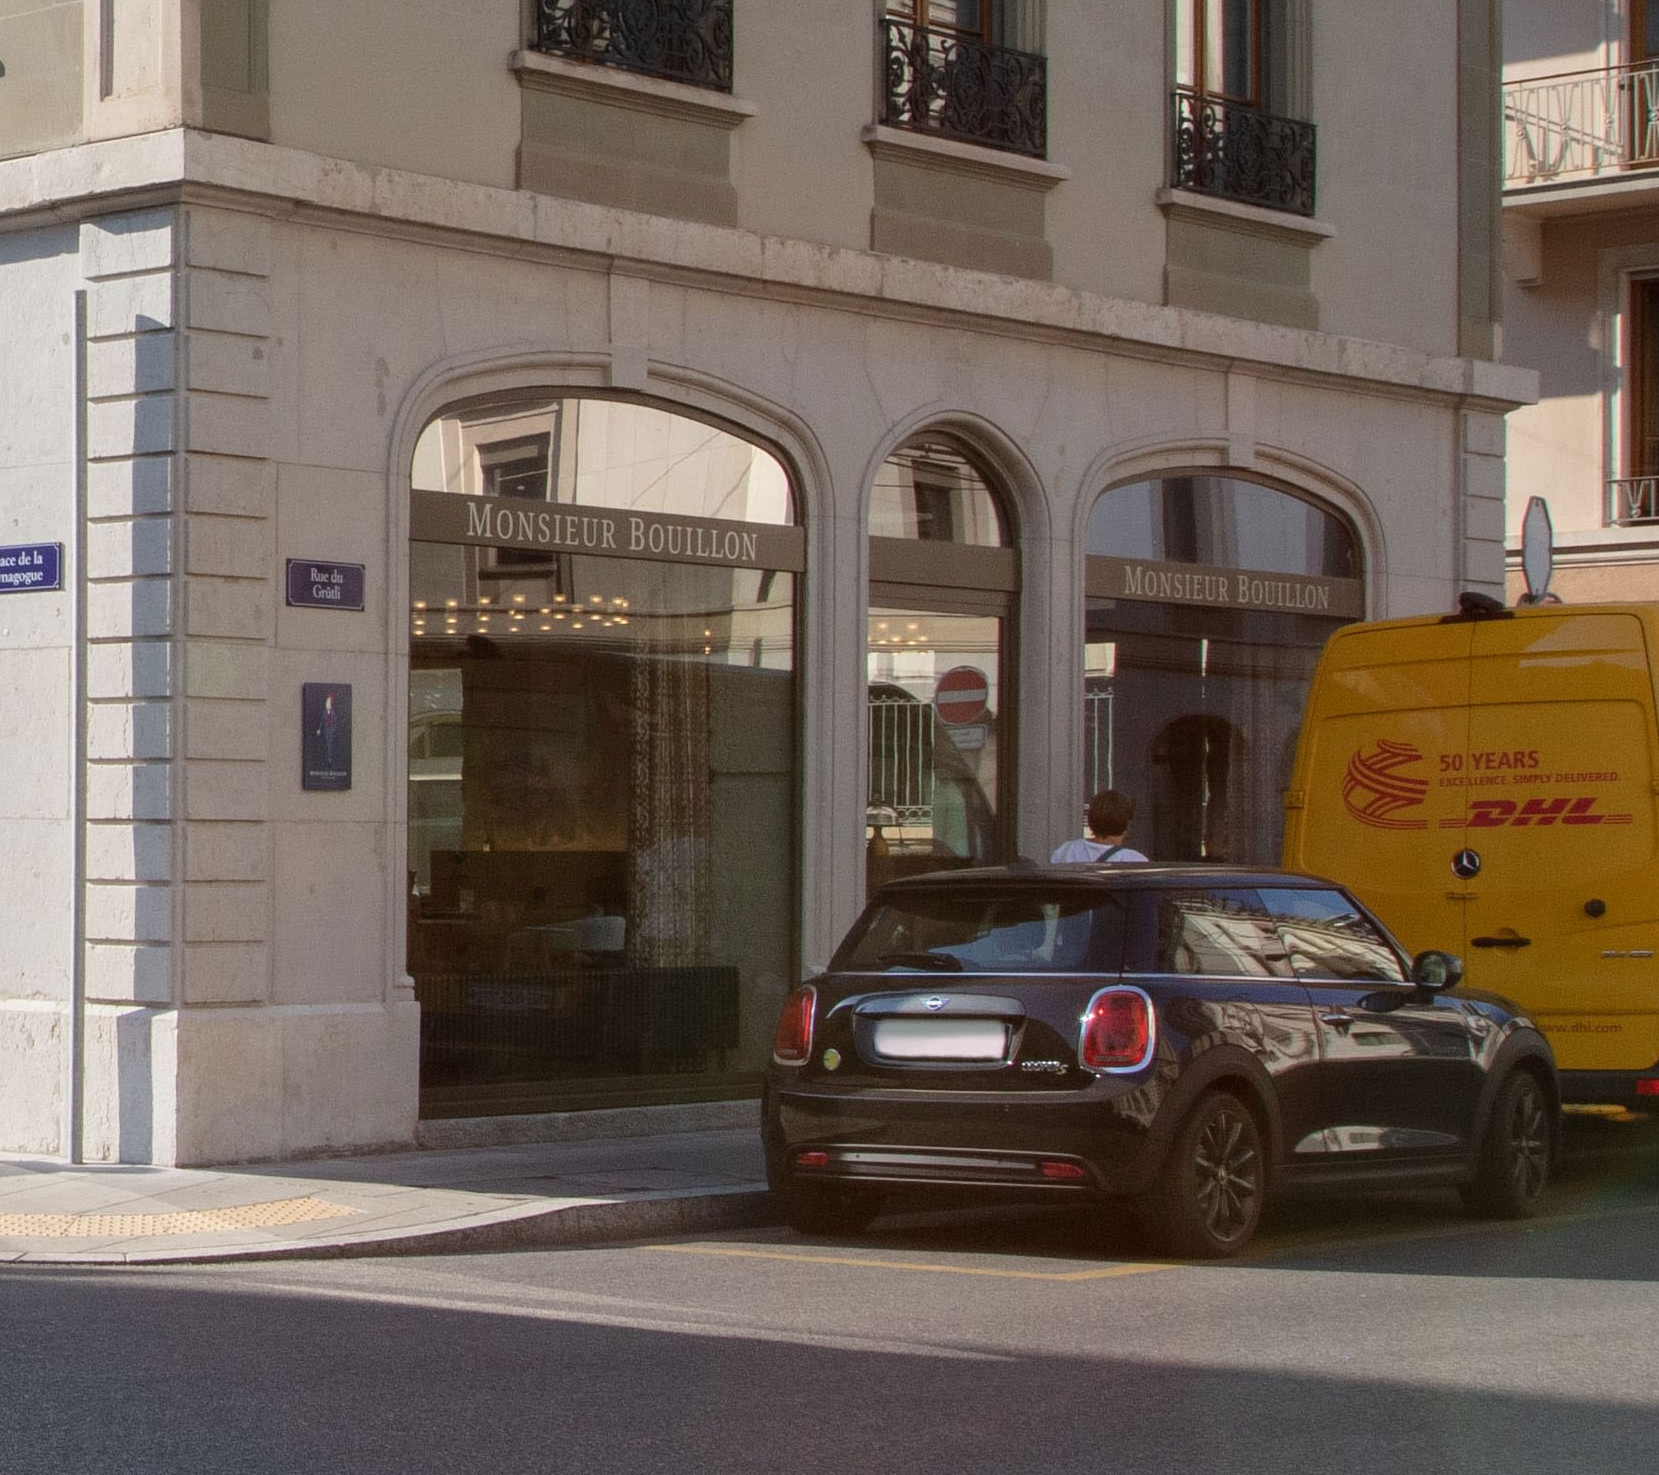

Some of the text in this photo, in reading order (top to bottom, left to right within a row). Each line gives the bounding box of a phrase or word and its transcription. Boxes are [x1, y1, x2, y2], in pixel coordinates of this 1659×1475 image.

[466, 501, 758, 562] MONSIEUR BOUILLON
[18, 551, 31, 566] de
[33, 550, 43, 564] la
[310, 567, 343, 583] Rue du
[312, 584, 341, 599] Grütli
[1124, 565, 1330, 610] MONSIEUR BOUILLON
[1439, 750, 1539, 772] 50 YEARS
[1512, 773, 1552, 784] SIMPLY
[1466, 797, 1606, 828] DHL
